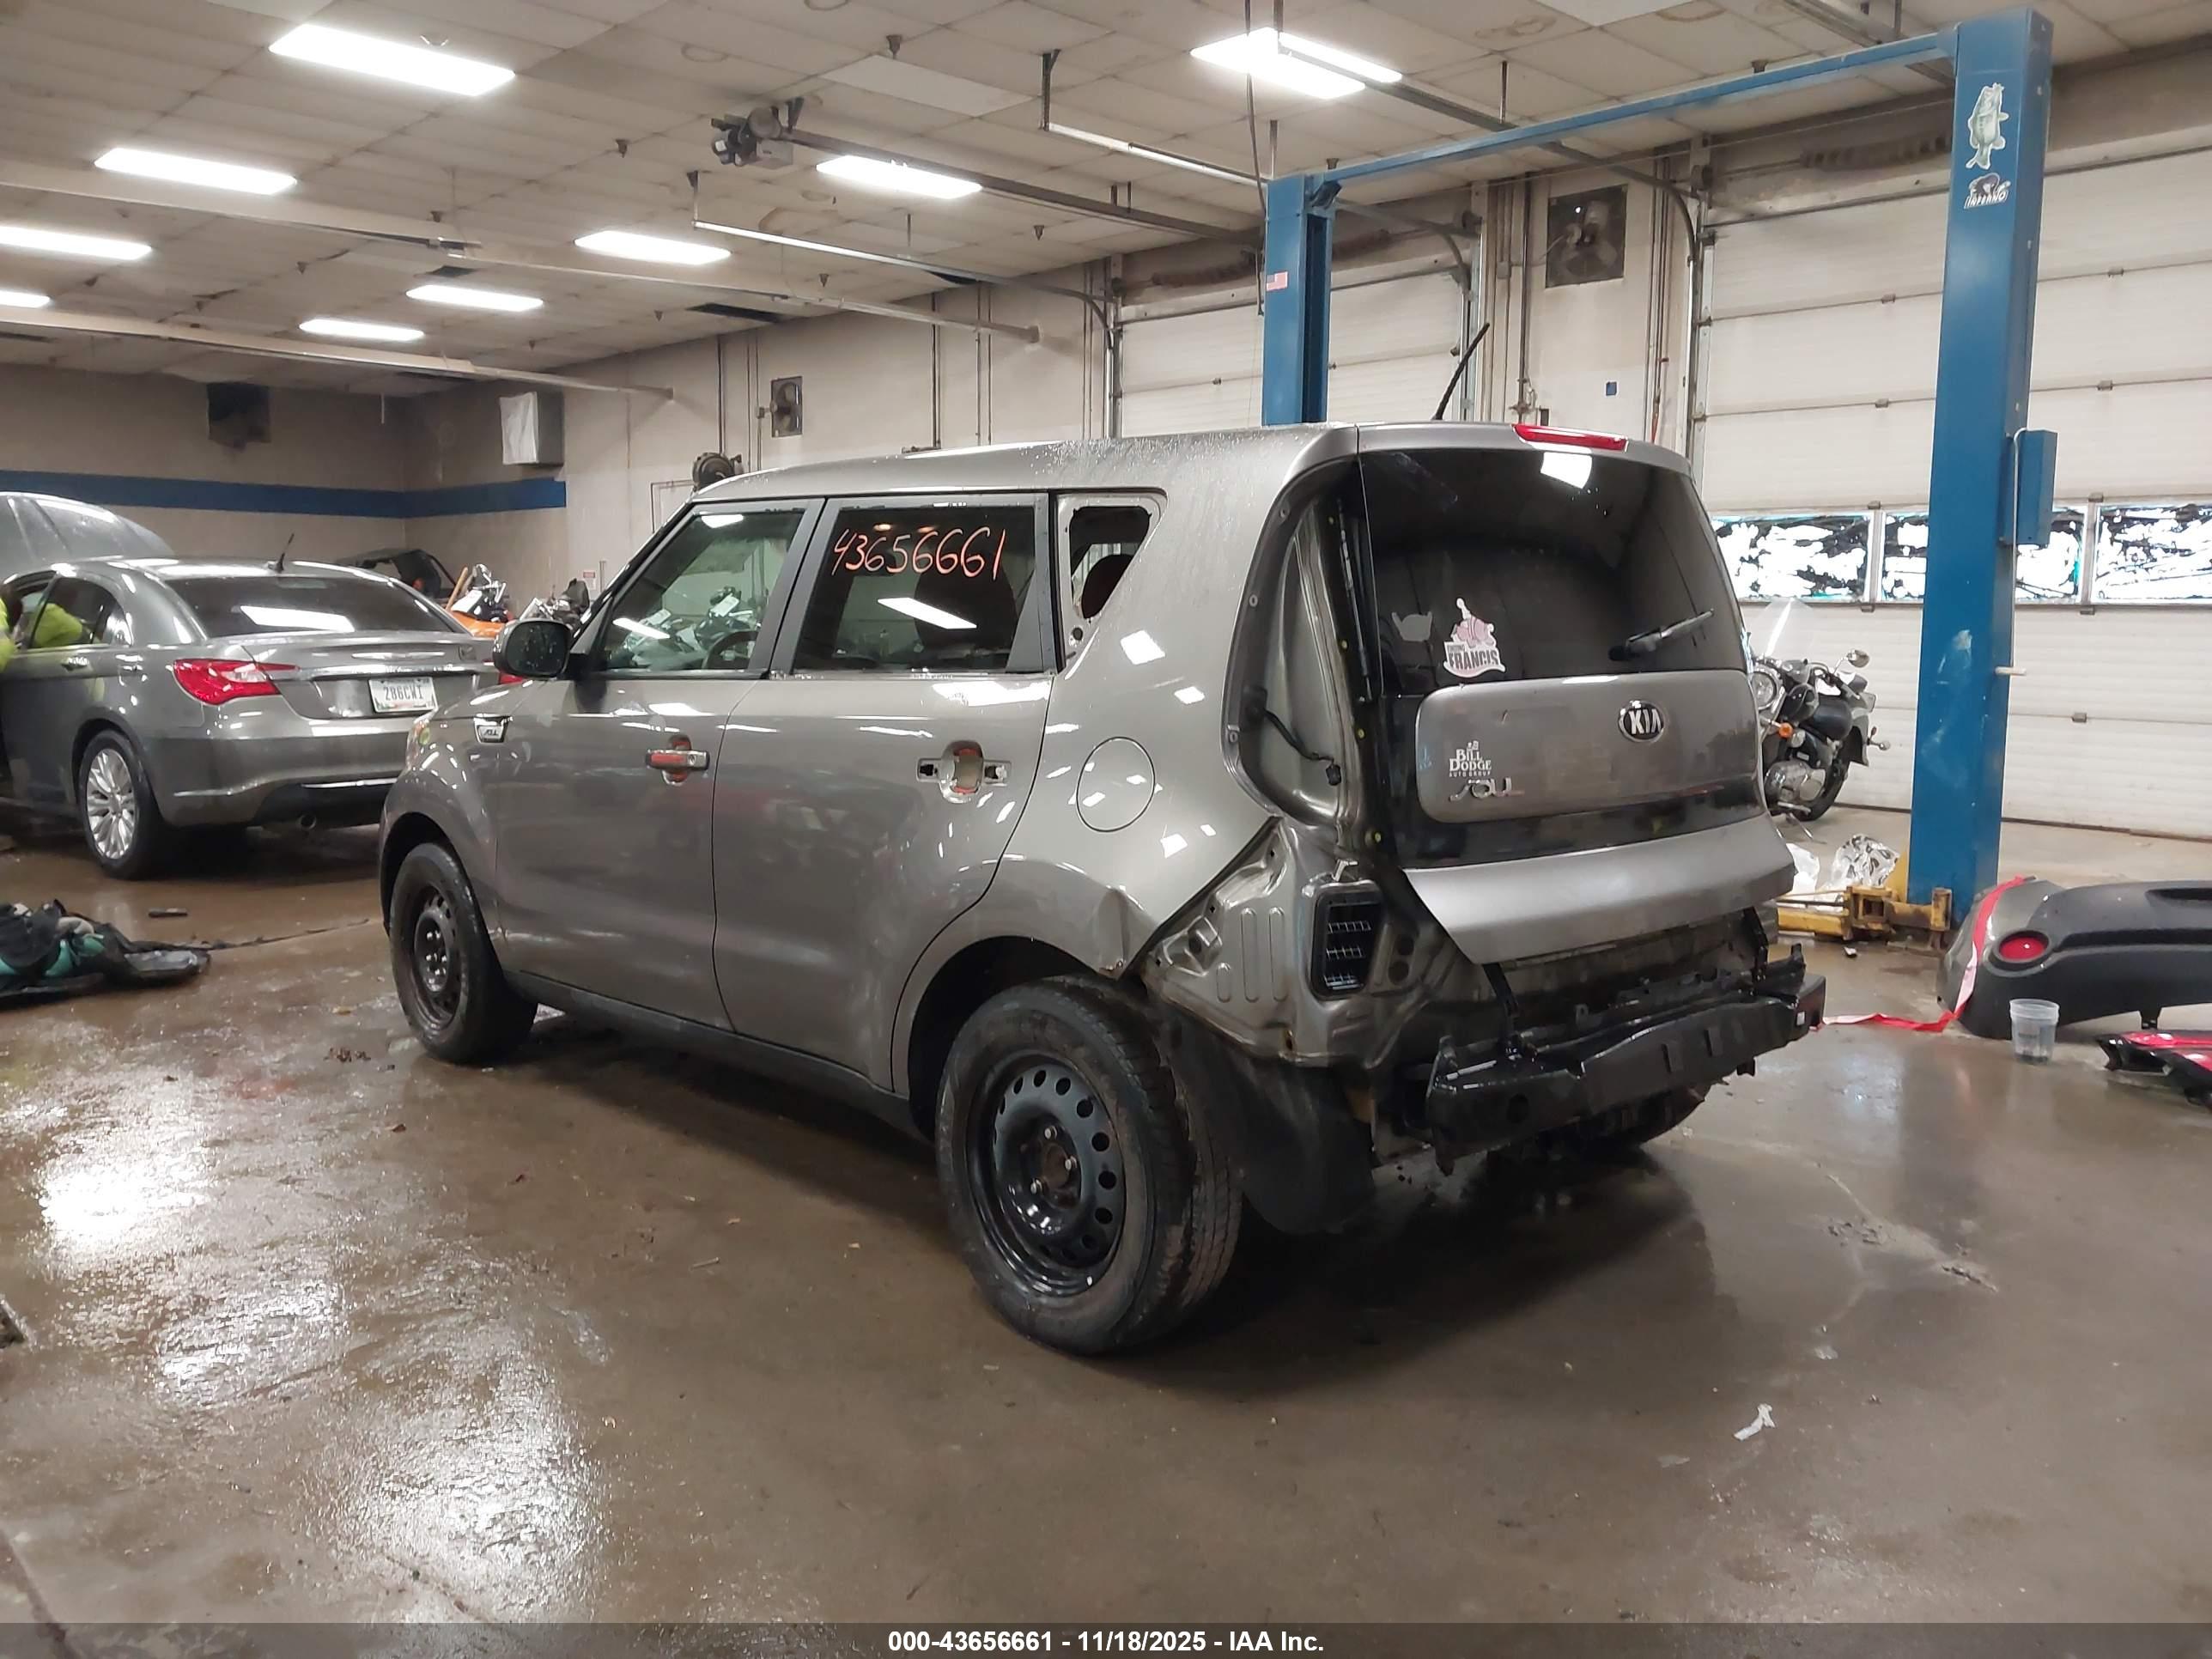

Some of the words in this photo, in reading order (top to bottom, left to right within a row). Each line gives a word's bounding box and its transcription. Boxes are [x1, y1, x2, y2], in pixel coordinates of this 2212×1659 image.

[831, 526, 1006, 580] 43656661
[1448, 650, 1499, 671] FRANCIS
[1628, 708, 1662, 735] KIA
[1449, 758, 1492, 772] DODGE
